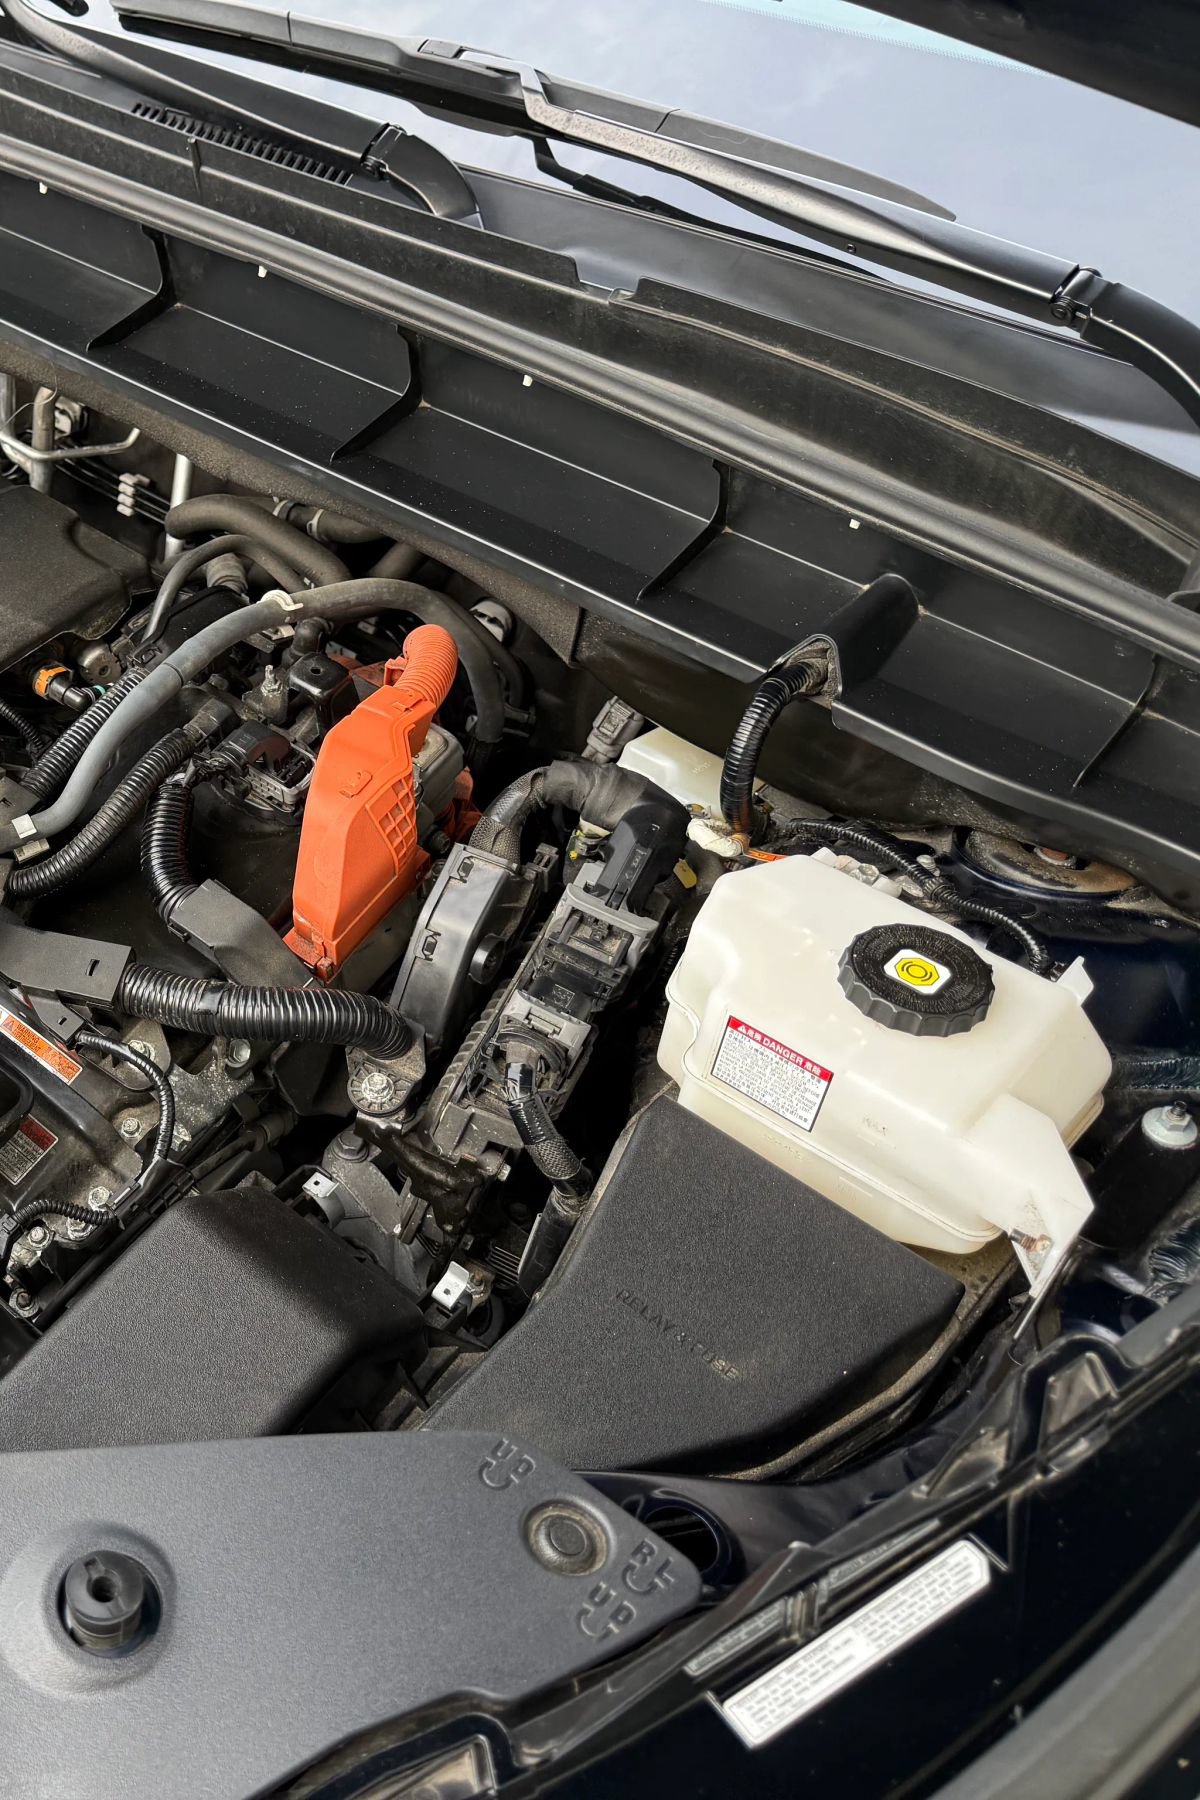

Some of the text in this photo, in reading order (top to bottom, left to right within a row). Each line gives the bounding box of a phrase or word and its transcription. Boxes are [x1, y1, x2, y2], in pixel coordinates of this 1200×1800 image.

[16, 1023, 40, 1044] WARNING
[762, 1037, 804, 1065] DANGER
[616, 1288, 676, 1332] RELAY
[690, 1341, 740, 1379] FUSE
